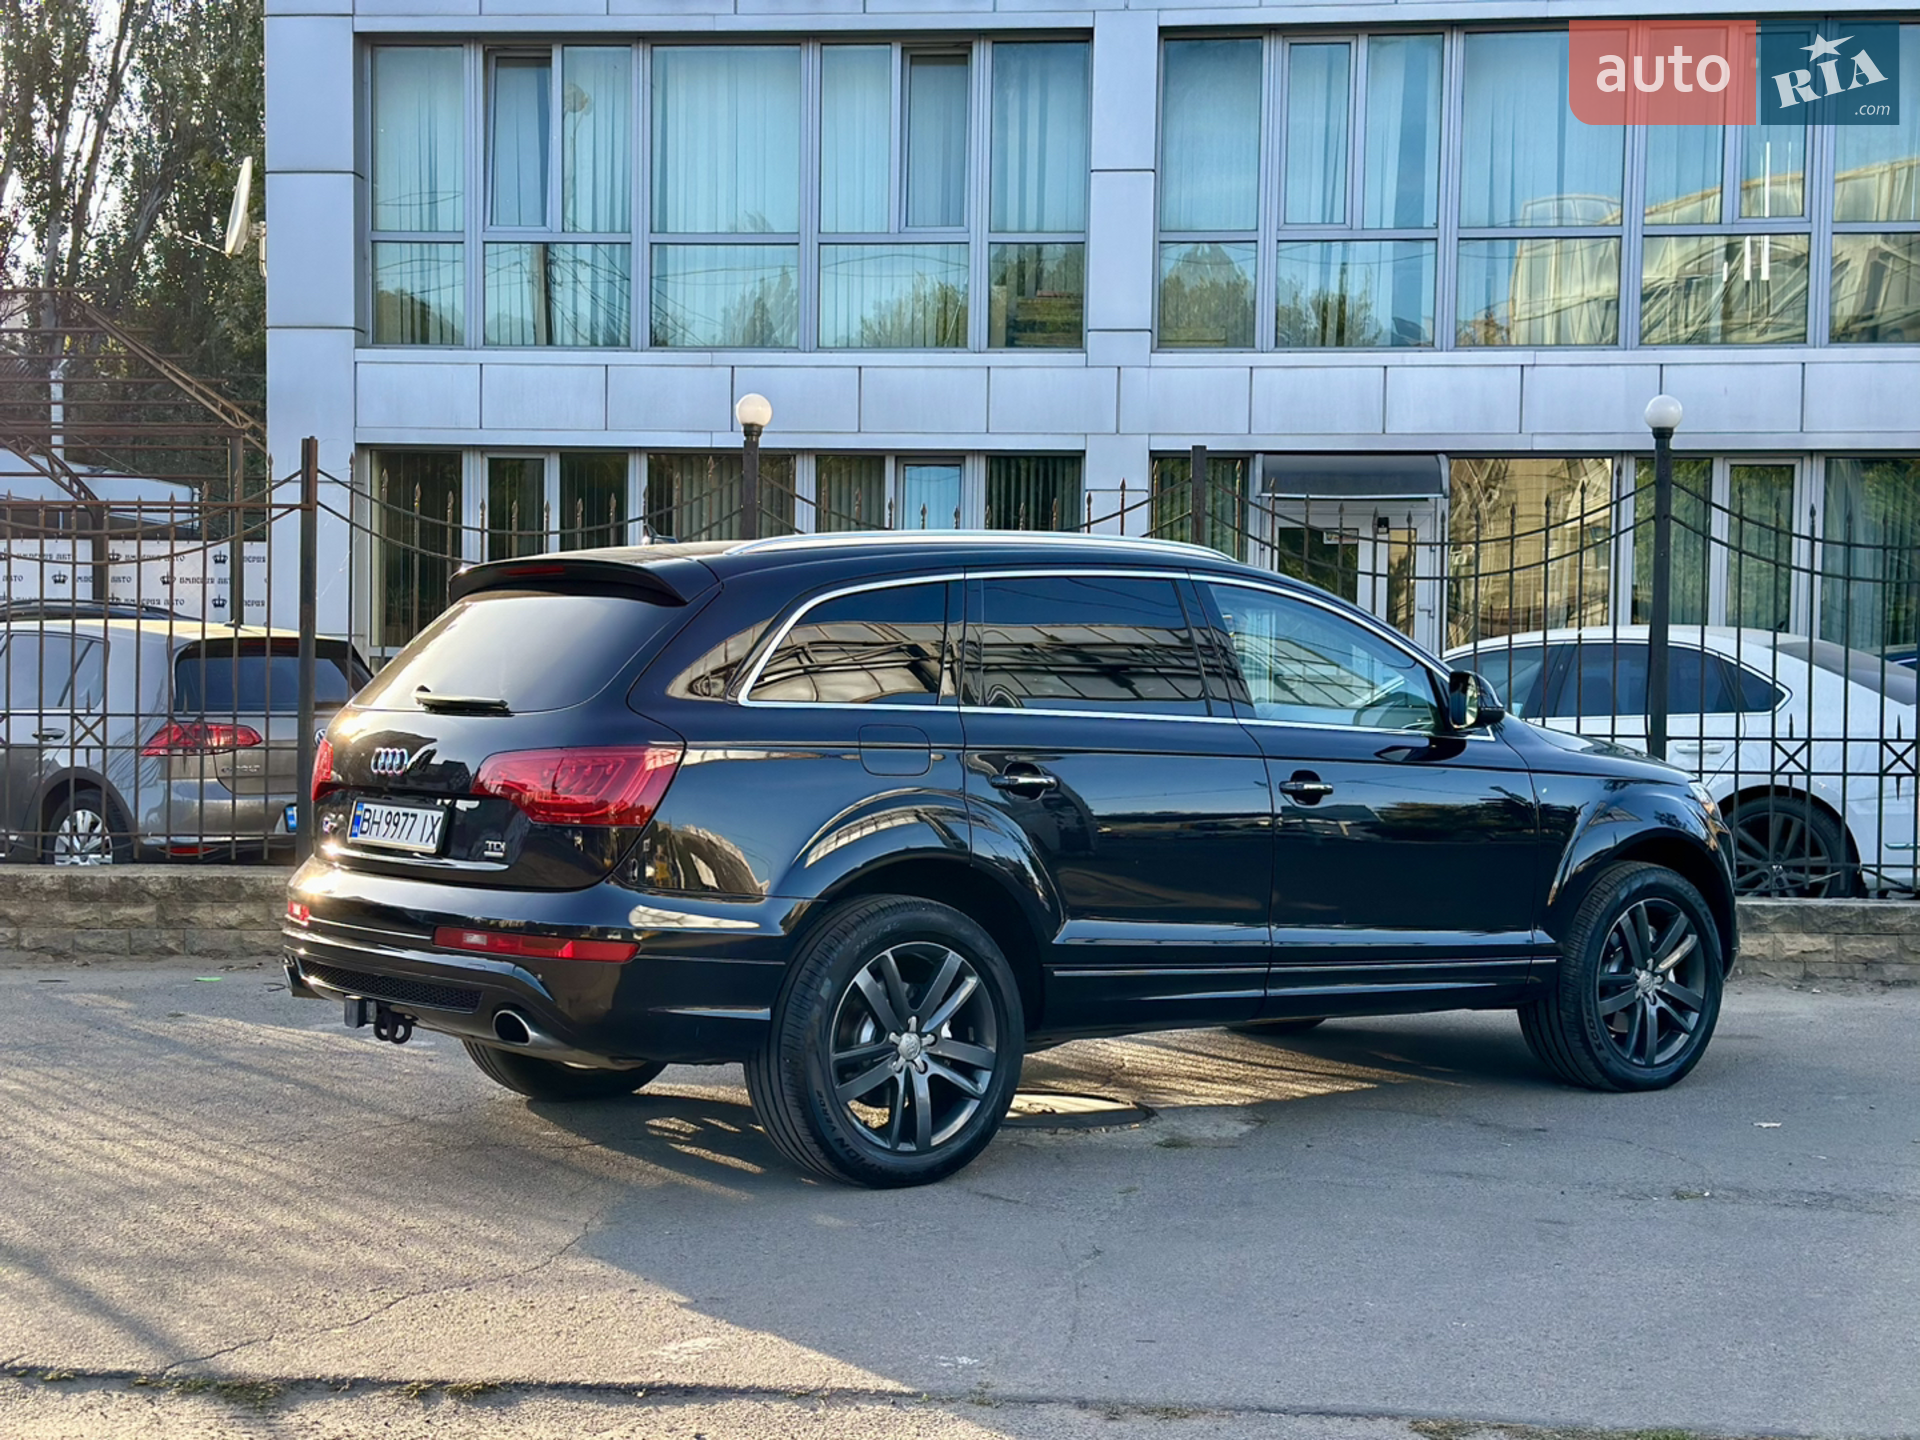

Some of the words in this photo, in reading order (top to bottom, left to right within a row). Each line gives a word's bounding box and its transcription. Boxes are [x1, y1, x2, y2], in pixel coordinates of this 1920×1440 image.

[179, 576, 215, 584] ИМПЕИЯ
[360, 808, 383, 836] BH
[382, 811, 417, 840] 9977
[420, 814, 441, 844] IX
